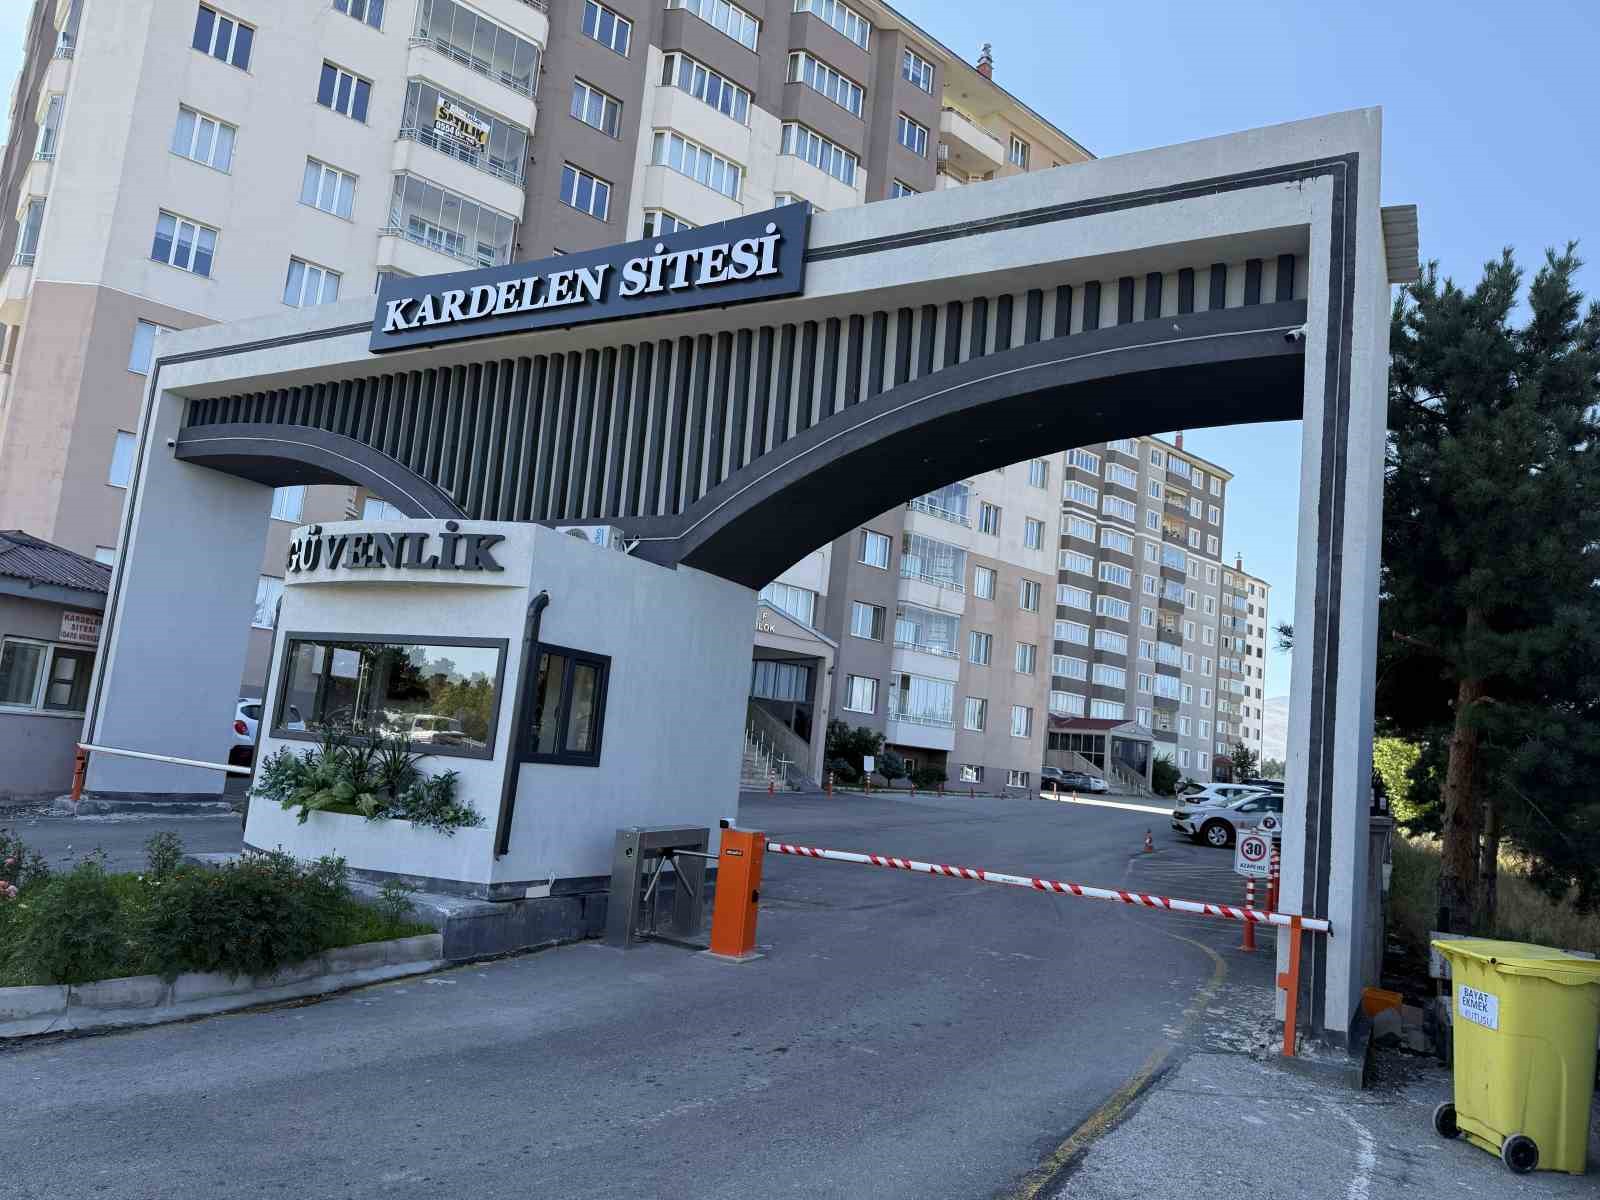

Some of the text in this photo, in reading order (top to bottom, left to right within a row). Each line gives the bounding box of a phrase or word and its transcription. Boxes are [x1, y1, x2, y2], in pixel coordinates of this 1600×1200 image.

[438, 106, 484, 143] SATILIK
[382, 222, 781, 334] KARDELEN SİTESİ
[287, 520, 505, 572] GÜVENLİK
[1245, 842, 1262, 856] 30
[1462, 996, 1488, 1013] EKMEK
[1464, 986, 1489, 1003] BAYAT
